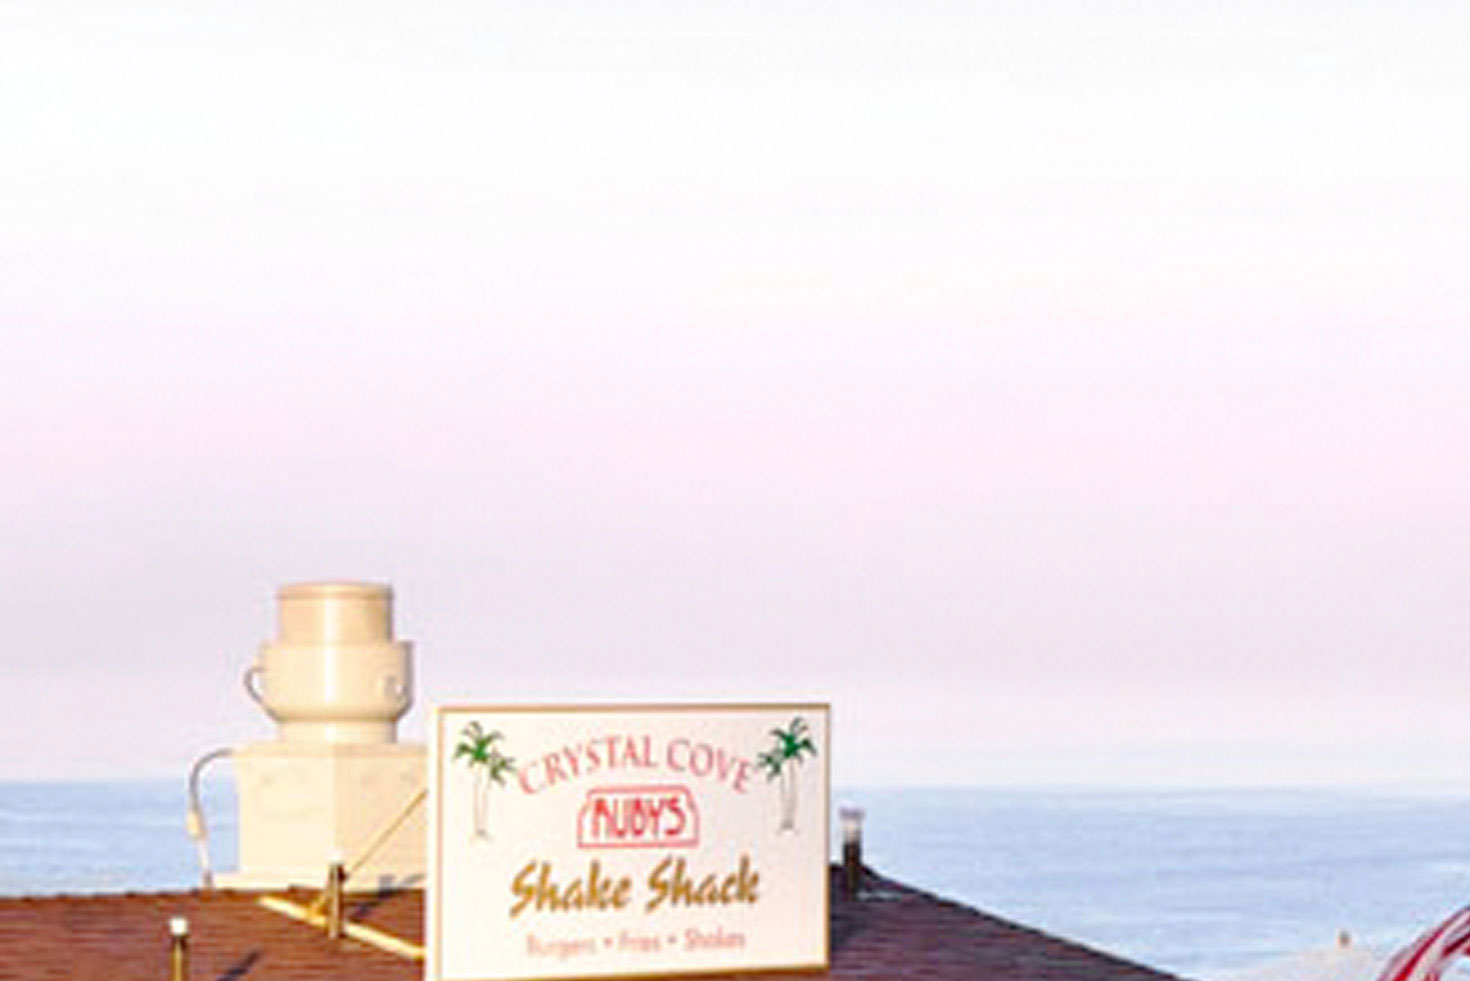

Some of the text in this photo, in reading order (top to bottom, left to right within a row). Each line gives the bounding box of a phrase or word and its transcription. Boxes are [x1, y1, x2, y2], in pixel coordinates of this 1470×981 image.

[517, 734, 752, 795] CRYSTAL COVE
[509, 853, 761, 918] Shake Shack
